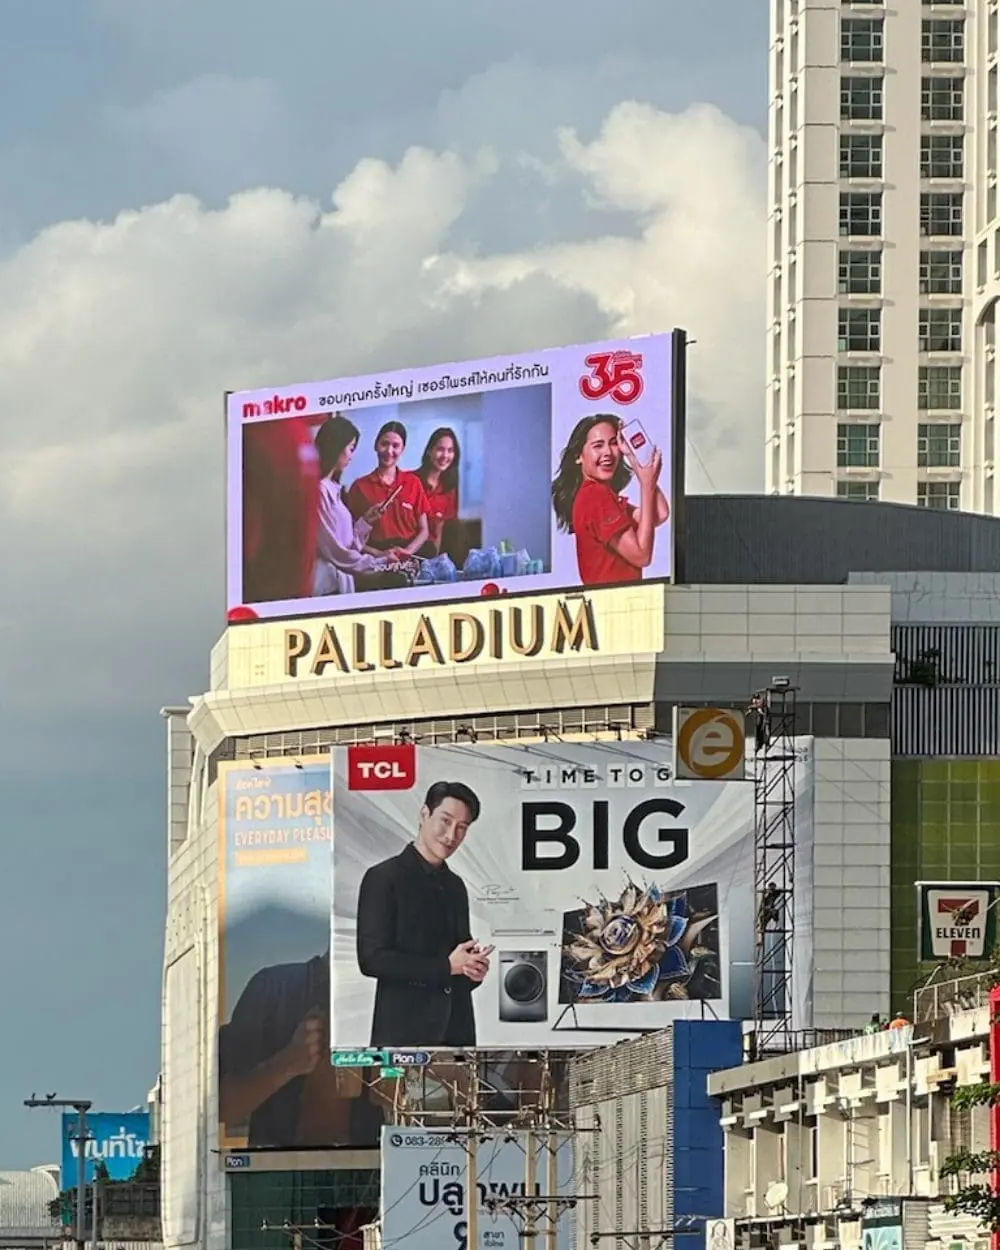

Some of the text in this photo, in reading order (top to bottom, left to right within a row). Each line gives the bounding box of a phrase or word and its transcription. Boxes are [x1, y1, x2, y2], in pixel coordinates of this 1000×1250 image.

[579, 350, 644, 405] 35
[243, 395, 307, 418] makro
[284, 598, 599, 677] PALLADIUM
[357, 761, 407, 779] TCL
[524, 769, 596, 784] TIME
[610, 768, 643, 782] TO
[235, 828, 291, 847] EVERYDAY
[521, 798, 689, 871] BIG
